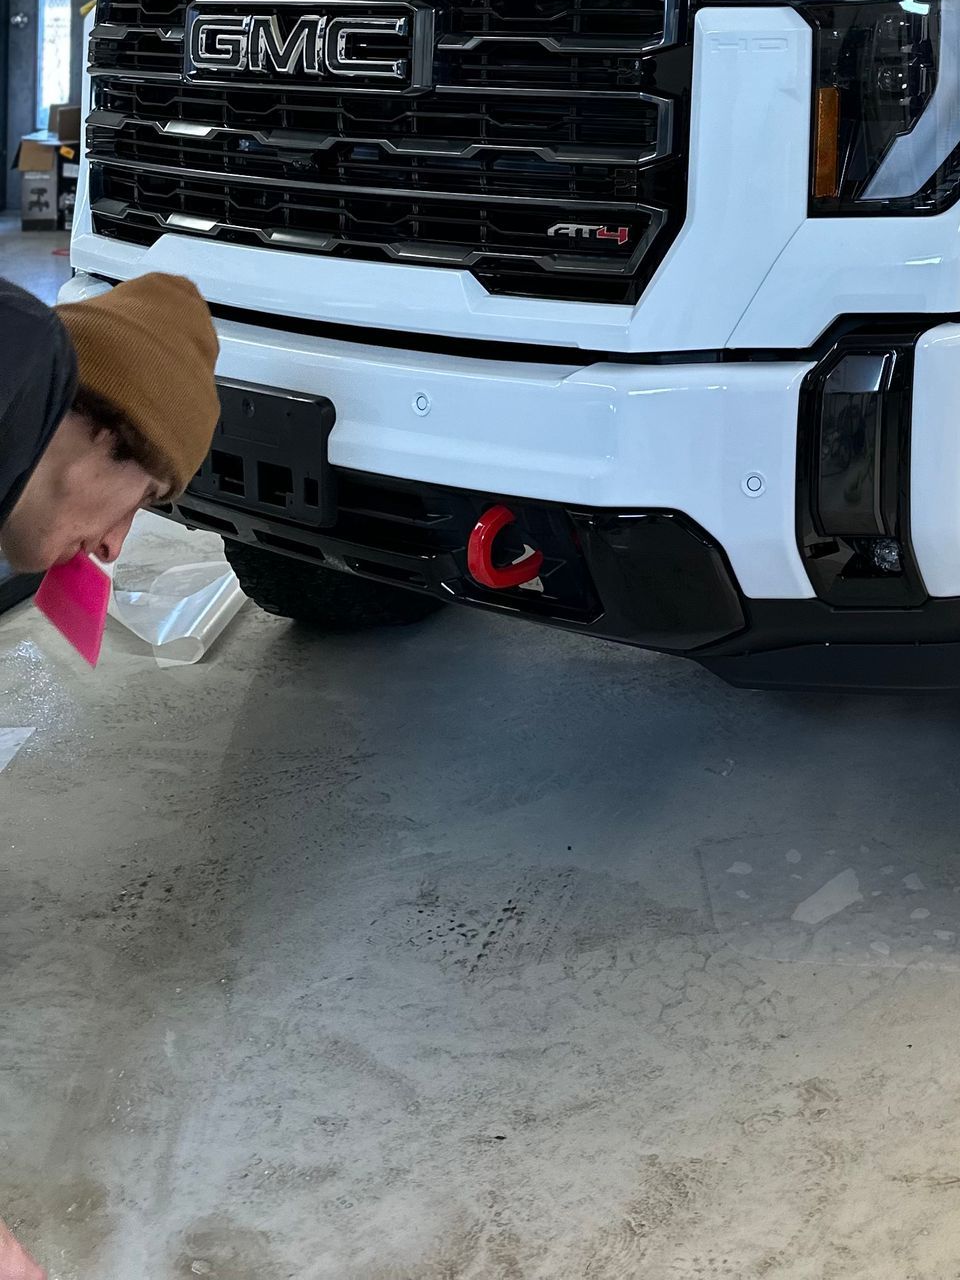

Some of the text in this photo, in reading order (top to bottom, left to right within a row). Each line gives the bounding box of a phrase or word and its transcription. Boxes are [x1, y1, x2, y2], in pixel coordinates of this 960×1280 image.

[190, 14, 407, 78] GMC
[710, 37, 788, 53] HD
[547, 223, 628, 245] AT4
